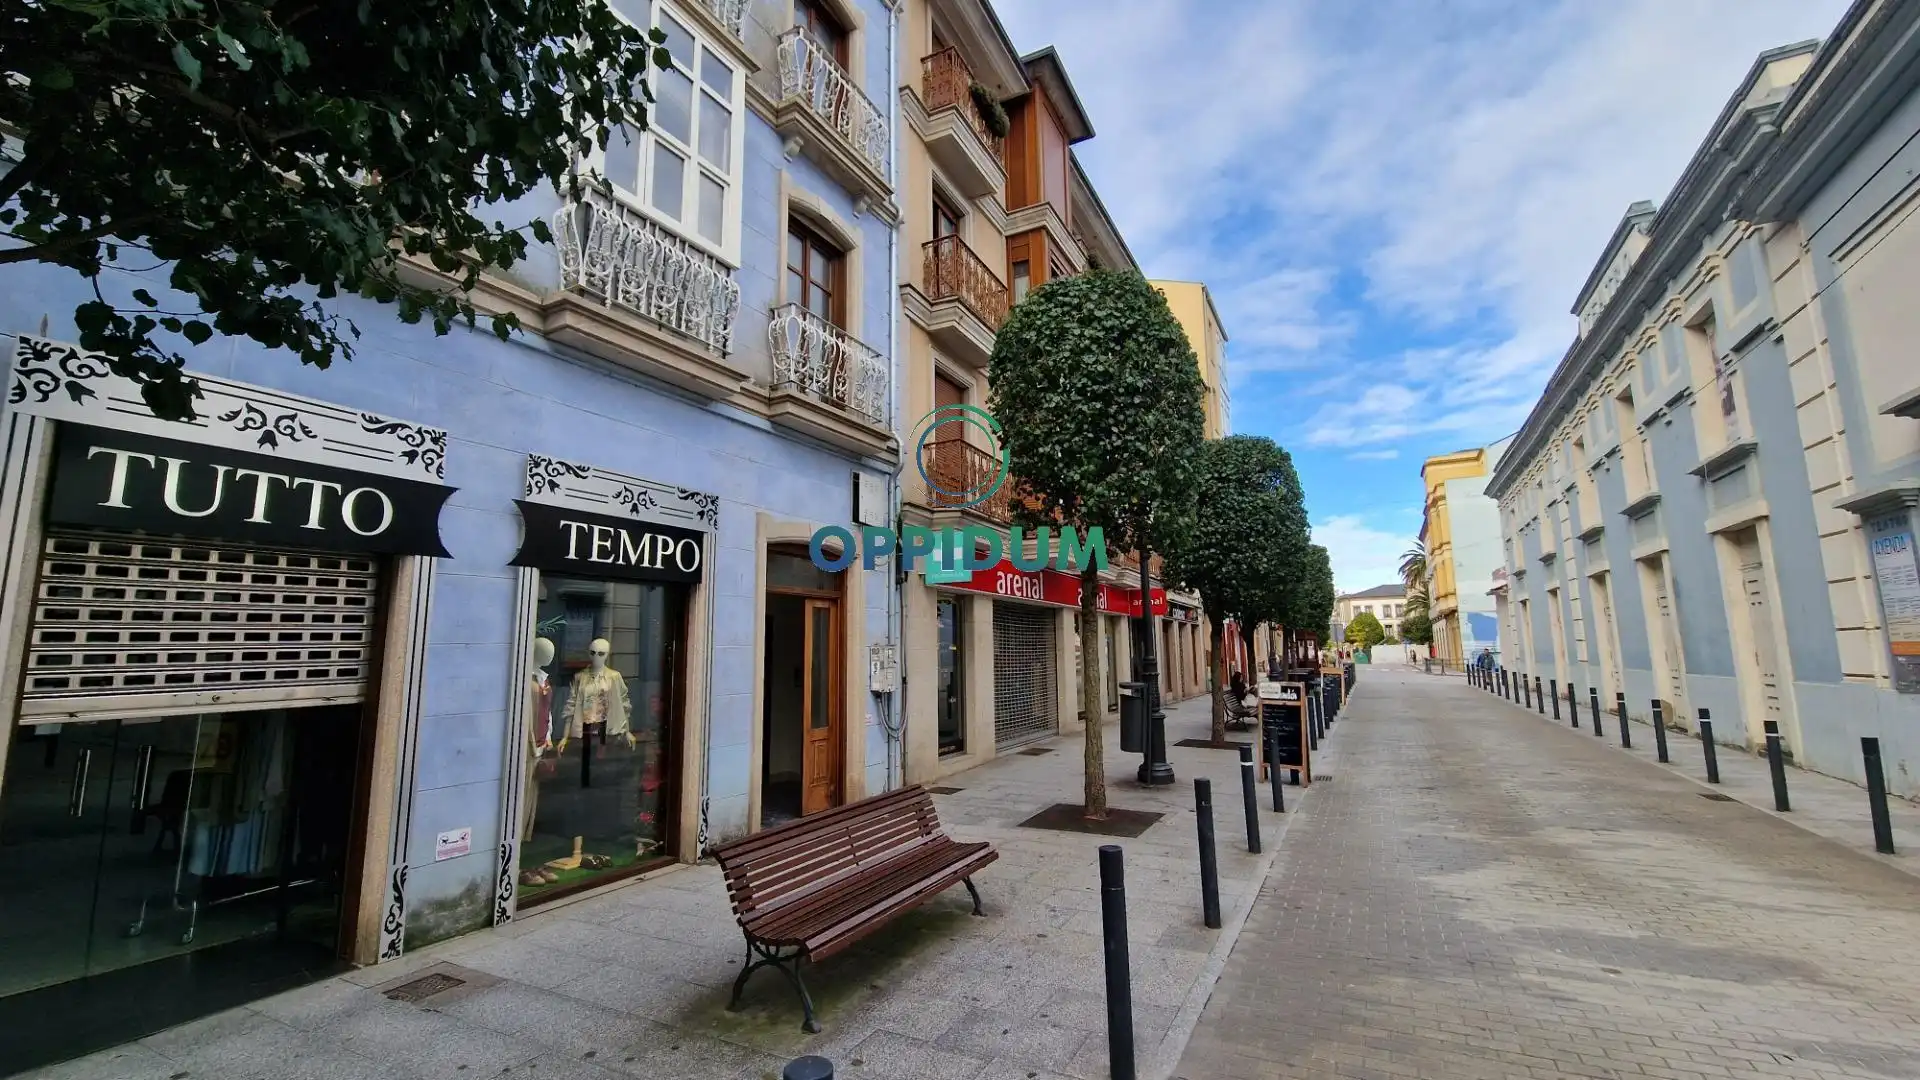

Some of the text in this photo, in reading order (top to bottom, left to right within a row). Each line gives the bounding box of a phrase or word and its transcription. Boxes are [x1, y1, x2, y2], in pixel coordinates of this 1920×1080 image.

[87, 445, 393, 536] TUTTO
[559, 519, 701, 572] TEMPO
[996, 570, 1044, 600] arenal
[1132, 596, 1163, 606] arnal
